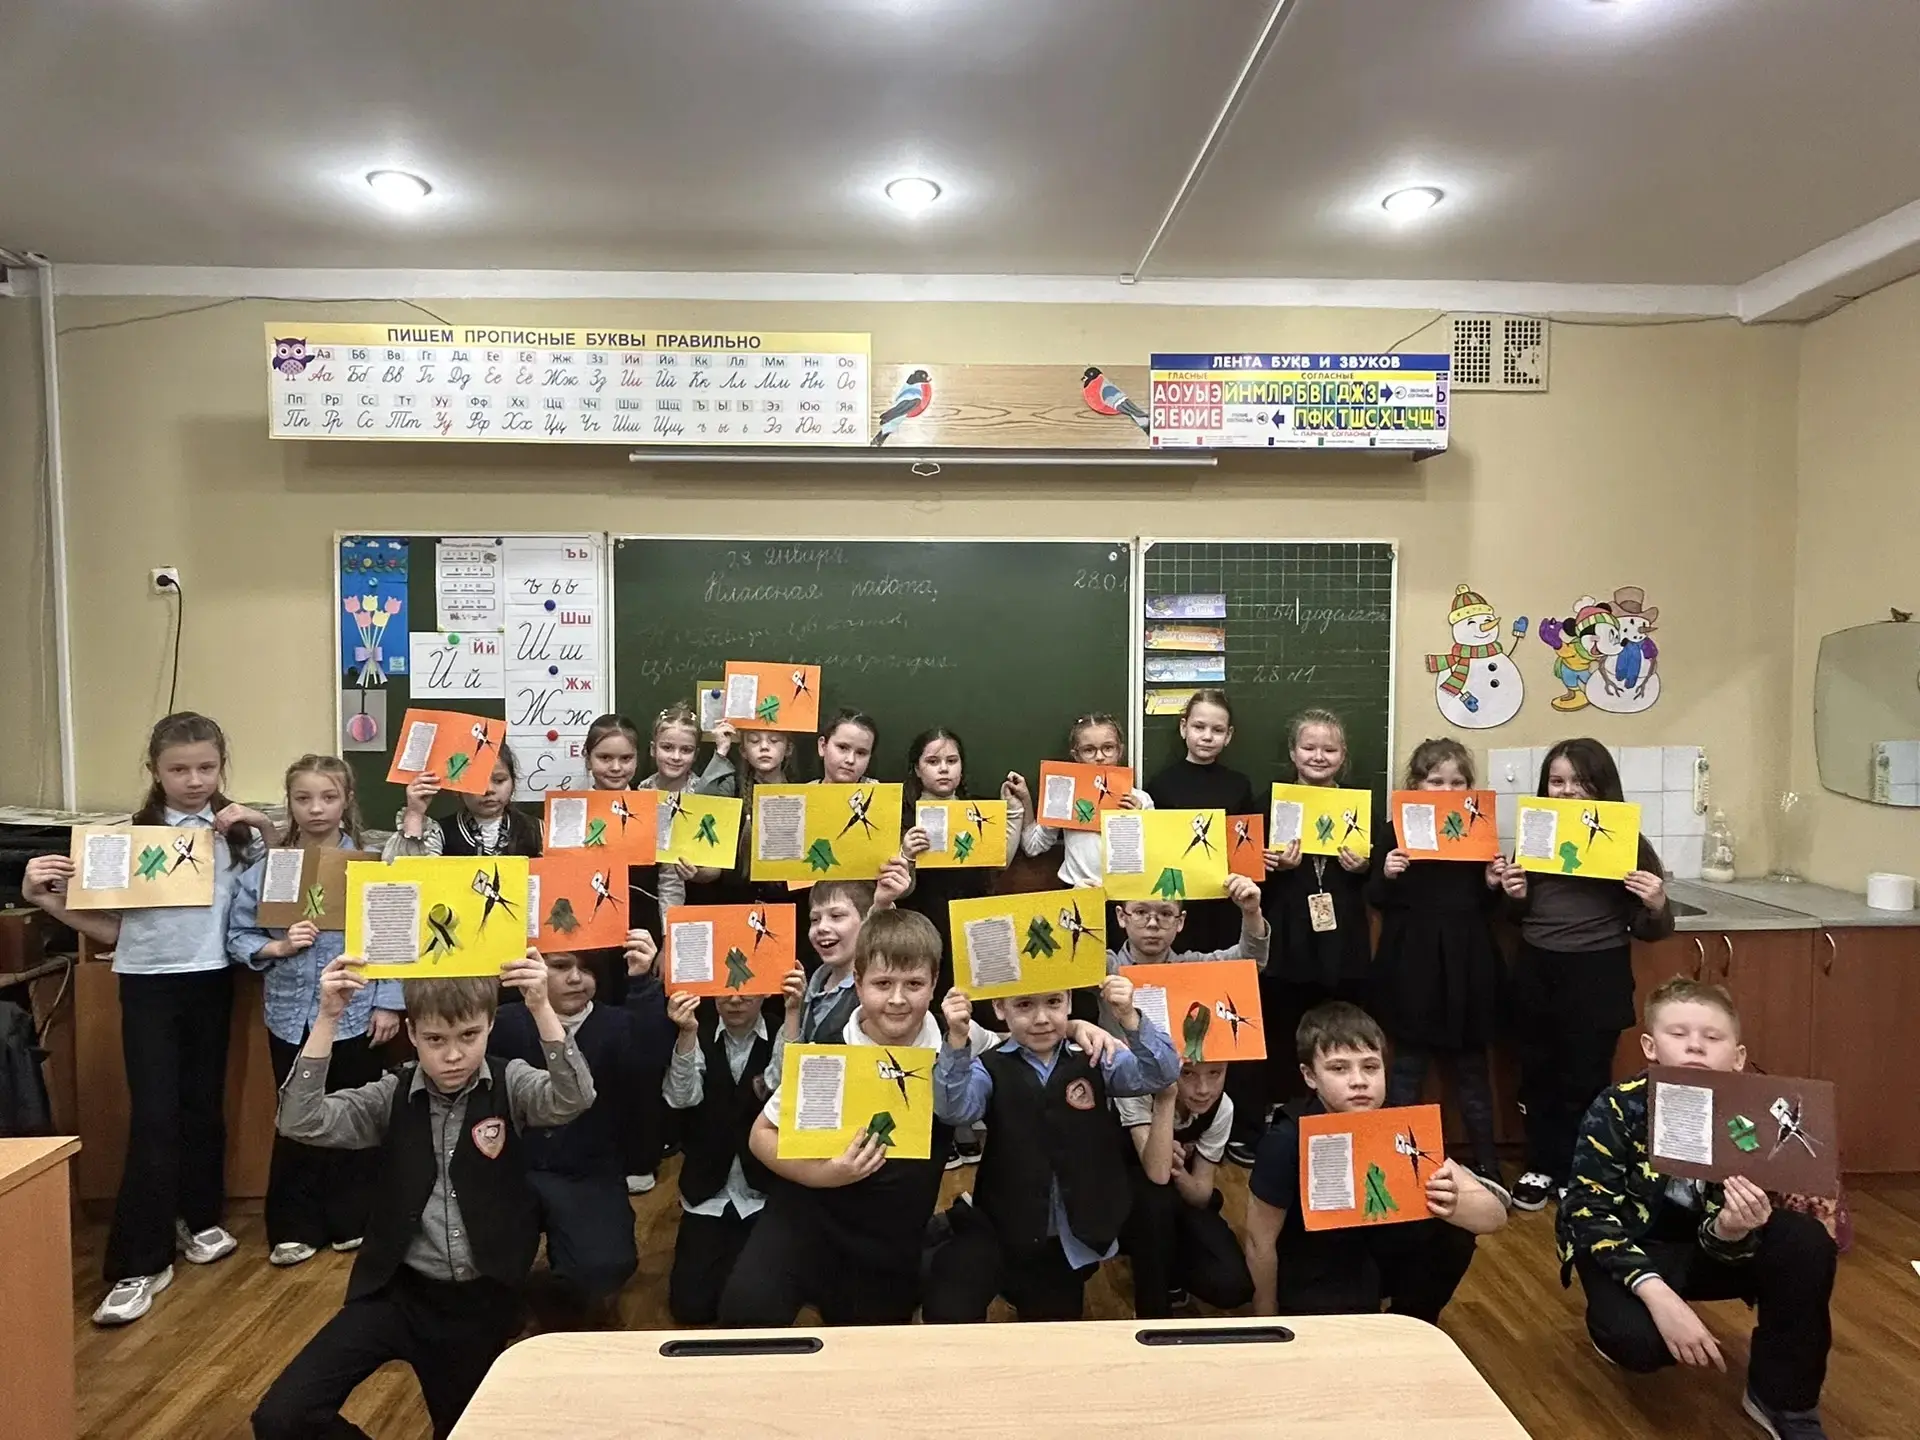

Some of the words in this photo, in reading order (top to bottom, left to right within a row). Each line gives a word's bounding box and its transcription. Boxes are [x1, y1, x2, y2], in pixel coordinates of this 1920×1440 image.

[388, 329, 454, 343] ПИШЕМ
[465, 330, 575, 346] ПРОПИСНЫЕ
[586, 333, 646, 348] БУКВЫ
[656, 334, 761, 349] ПРАВИЛЬНО
[317, 350, 331, 359] Аа
[352, 350, 366, 360] Бб
[387, 351, 401, 361] Вв
[422, 351, 433, 361] Гг
[452, 352, 468, 362] Дд
[487, 352, 500, 361] Ее
[552, 354, 572, 363] Жж
[592, 356, 604, 364] Зз
[624, 355, 640, 365] Ии
[660, 354, 675, 365] Йй
[695, 357, 708, 366] Кк
[730, 357, 744, 366] Лл
[765, 357, 785, 367] Мм
[804, 358, 820, 367] Нн
[838, 358, 854, 367] Оо
[1212, 356, 1262, 369] ЛЕНТА
[1271, 356, 1311, 369] БУКВ
[1319, 356, 1330, 368] И
[1340, 356, 1400, 369] ЗВУКОВ
[308, 366, 334, 383] Аа
[348, 365, 374, 382] Бб
[382, 367, 405, 383] Вв
[416, 366, 434, 384] Гг
[448, 367, 472, 390] Дд
[485, 367, 502, 384] Ее
[542, 369, 579, 386] Жж
[589, 369, 607, 392] Зз
[620, 369, 642, 387] Ии
[656, 368, 677, 387] Йй
[689, 370, 711, 388] Кк
[719, 372, 747, 388] Лл
[754, 372, 791, 389] Мм
[800, 372, 825, 389] Нн
[837, 371, 856, 390] Оо
[1301, 372, 1355, 380] СОГЛАСНЫЕ
[287, 395, 303, 405] Пп
[325, 395, 339, 406] Рр
[361, 396, 375, 405] Сс
[399, 397, 412, 405] Тт
[435, 397, 449, 408] Уу
[471, 397, 488, 408] Фф
[511, 399, 524, 407] Хх
[546, 399, 562, 409] Цц
[583, 399, 597, 408] Чч
[618, 400, 639, 410] Шш
[658, 400, 681, 411] Щщ
[767, 402, 781, 411] Ээ
[800, 402, 820, 411] Юю
[839, 402, 853, 411] Яя
[283, 409, 310, 427] Пп
[322, 409, 343, 433] Рр
[357, 410, 374, 428] Сс
[386, 410, 421, 428] Тт
[433, 412, 452, 435] Уу
[466, 411, 490, 436] Фф
[502, 413, 532, 430] Хх
[544, 413, 567, 435] Цц
[580, 414, 602, 433] Чч
[612, 415, 642, 433] Шш
[653, 415, 684, 437] Щщ
[704, 571, 822, 603] Классная
[560, 611, 592, 626] Шш
[472, 638, 495, 655] Йй
[517, 622, 556, 661] Ш
[559, 644, 584, 661] ш
[428, 646, 458, 689] Й
[464, 667, 482, 688] й
[565, 677, 592, 691] Жж
[511, 688, 563, 727] Ж
